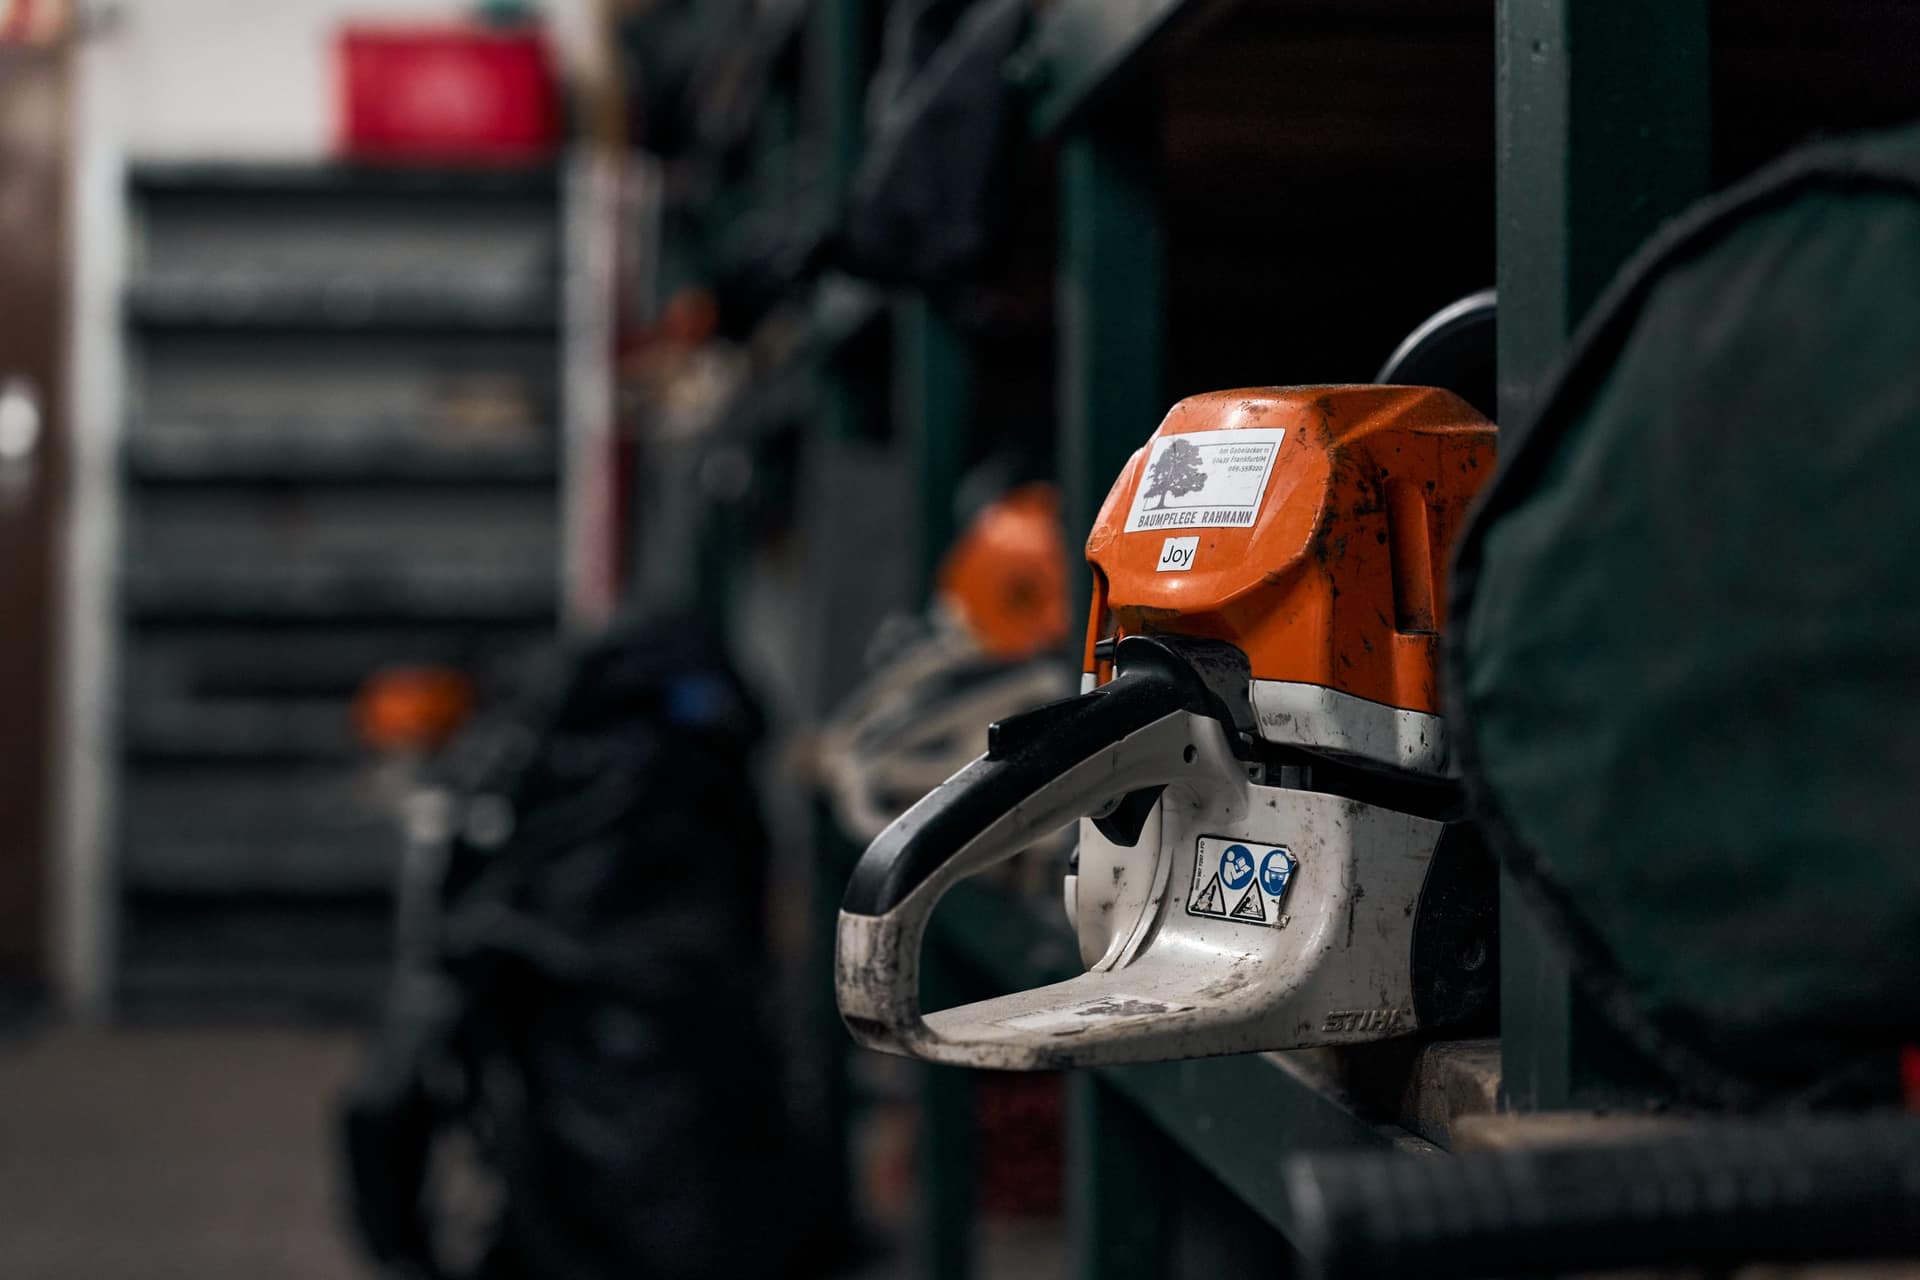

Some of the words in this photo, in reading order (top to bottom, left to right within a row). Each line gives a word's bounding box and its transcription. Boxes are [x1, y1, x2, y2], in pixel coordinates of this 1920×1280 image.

[1137, 511, 1198, 528] BAUMPFLEGE
[1201, 511, 1253, 524] RAHMANN
[1162, 545, 1194, 567] Joy
